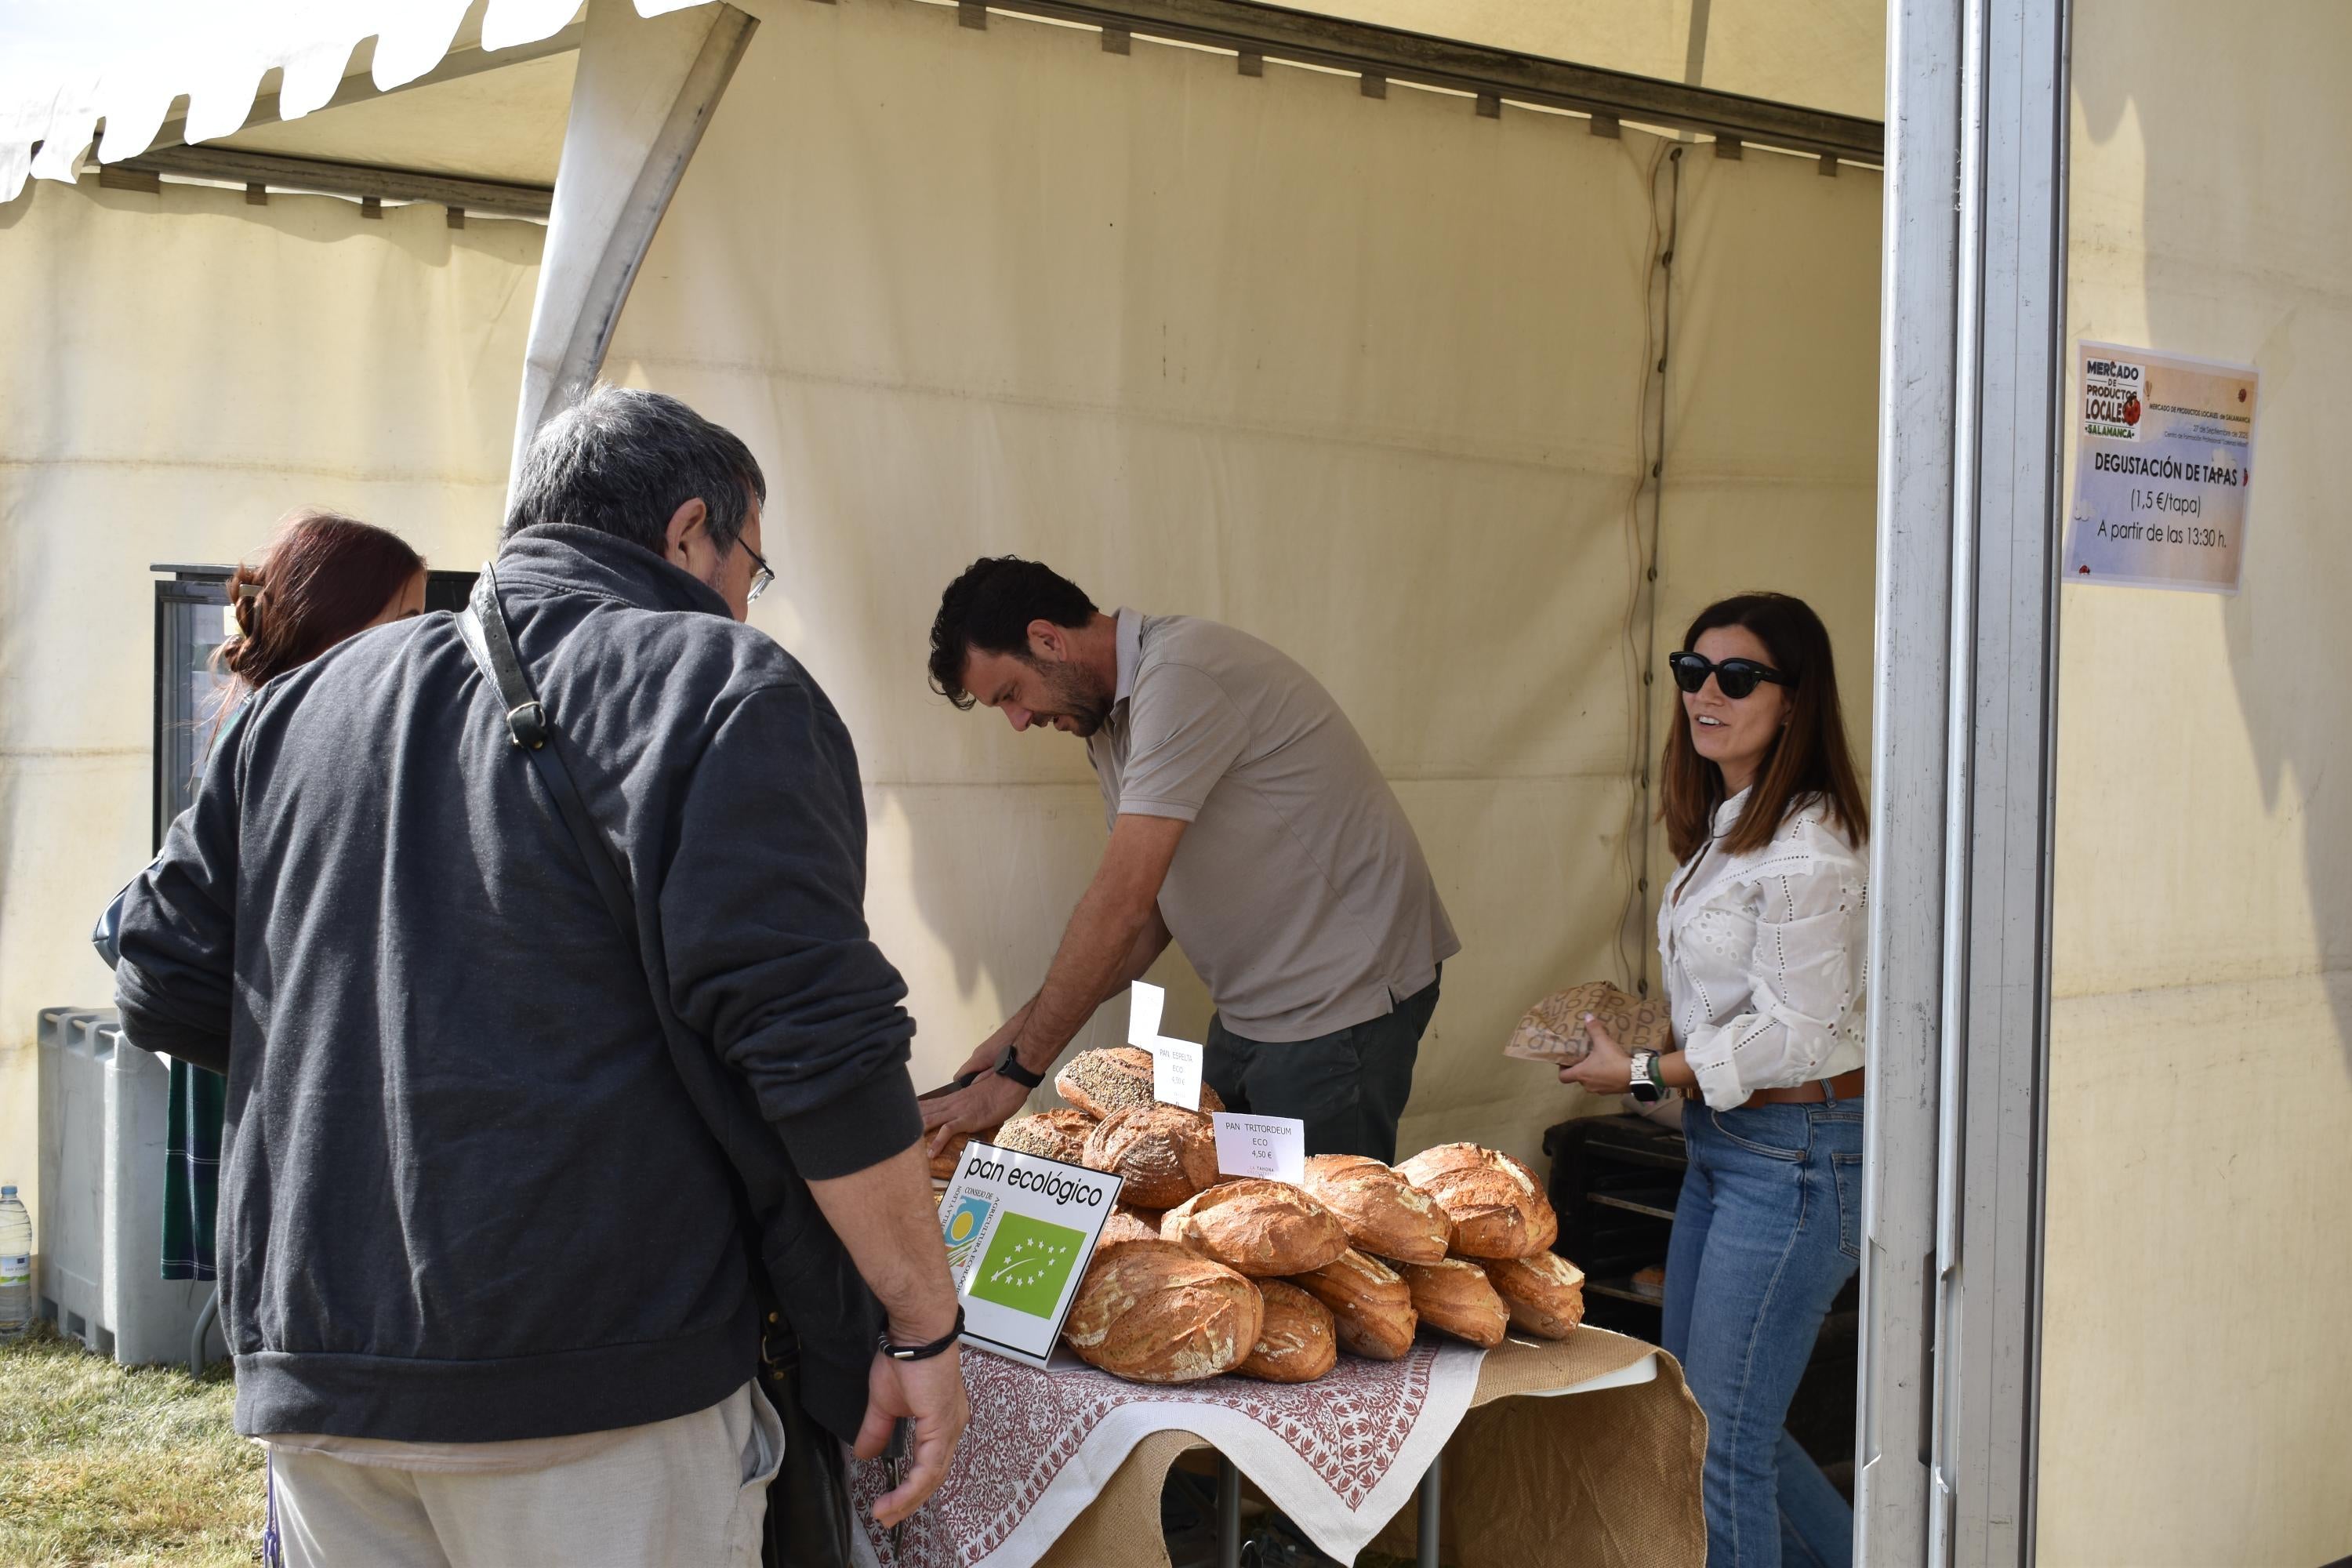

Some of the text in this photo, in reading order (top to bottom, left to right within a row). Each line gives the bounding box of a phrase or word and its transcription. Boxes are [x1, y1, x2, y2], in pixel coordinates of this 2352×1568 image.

[2087, 361, 2139, 380] MERCADO
[2108, 378, 2117, 387] DE
[2085, 398, 2126, 423] LOCALE
[2149, 403, 2170, 412] MERCADO
[2095, 452, 2237, 486] DEGUSTACIÓN DE TAPAS
[2131, 488, 2201, 518] (1,5 €/tapa)
[2097, 519, 2227, 548] A partir de las 13:30 h.
[1160, 1048, 1170, 1058] PAN
[1225, 1122, 1291, 1135] PAN TRITORDEUM
[1252, 1138, 1268, 1146] ECO
[1252, 1150, 1265, 1159] 4,50
[964, 1157, 1102, 1207] pan ecológico
[964, 1186, 994, 1200] CONSEJO DE
[972, 1196, 1000, 1254] AGRICULTURA
